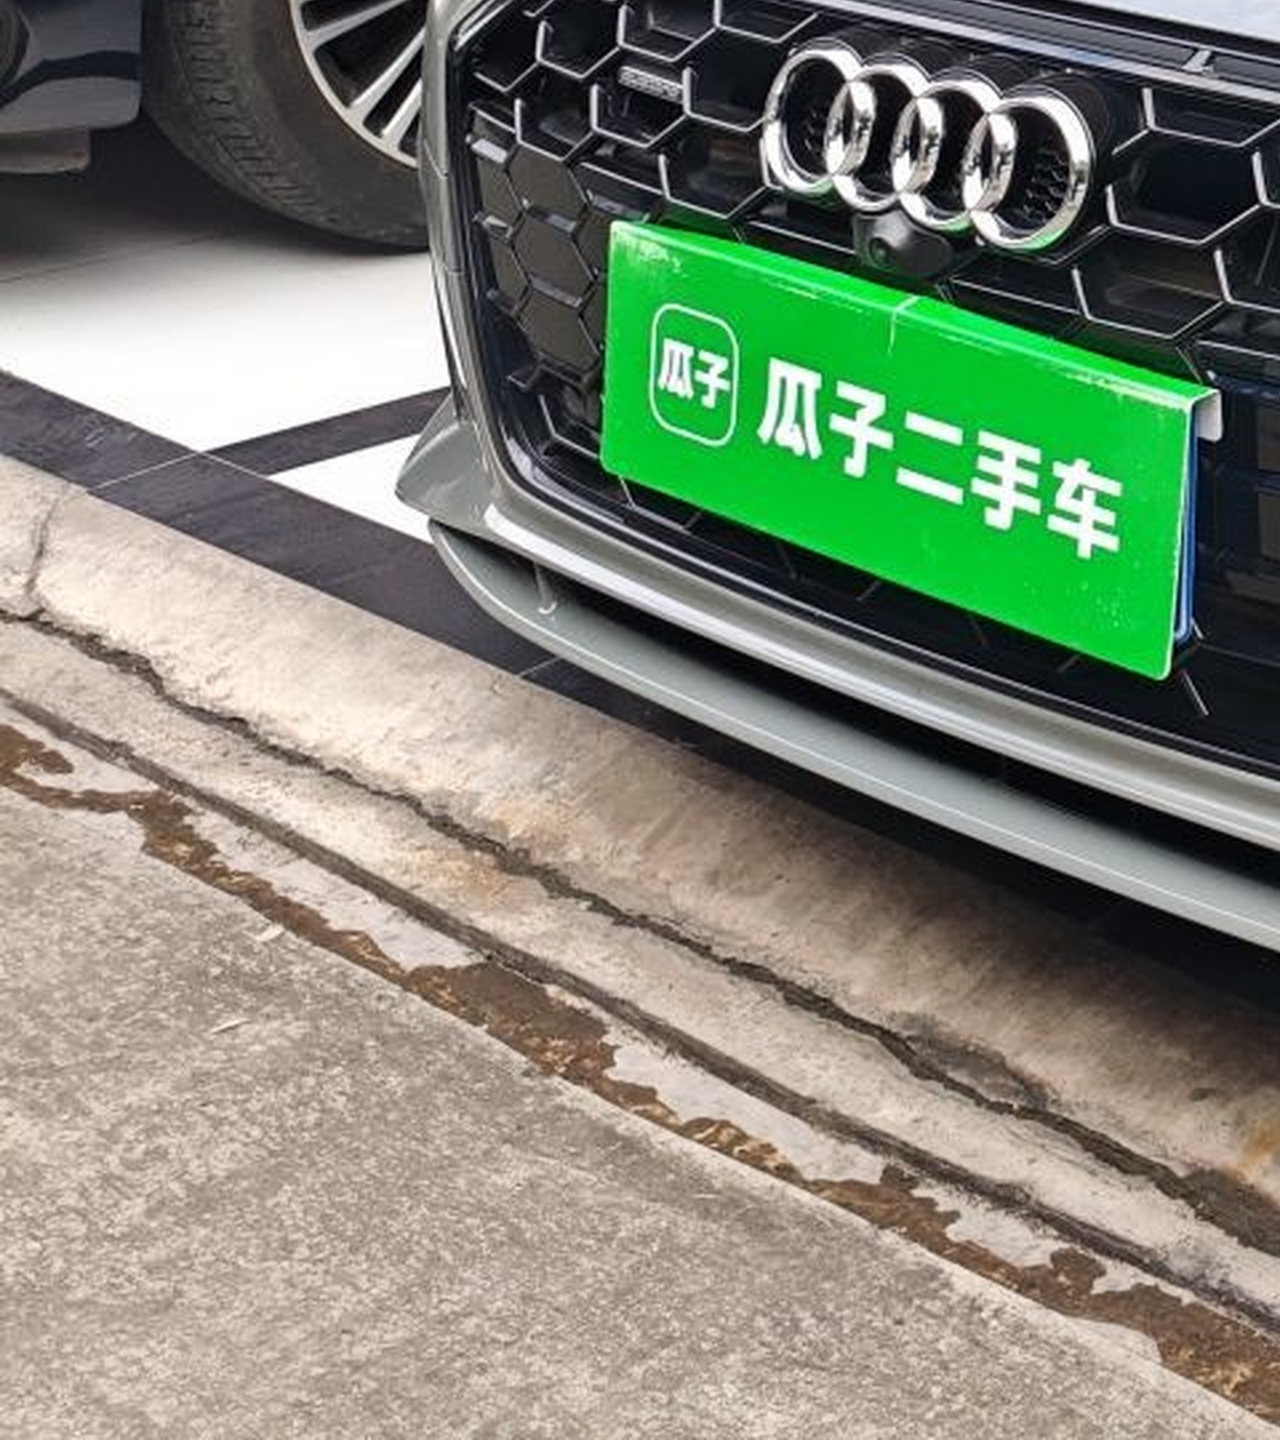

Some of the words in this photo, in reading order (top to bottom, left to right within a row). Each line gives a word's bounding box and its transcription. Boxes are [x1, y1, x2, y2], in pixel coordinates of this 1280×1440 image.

[657, 337, 730, 408] 瓜子
[757, 357, 1122, 559] 瓜子二手车
